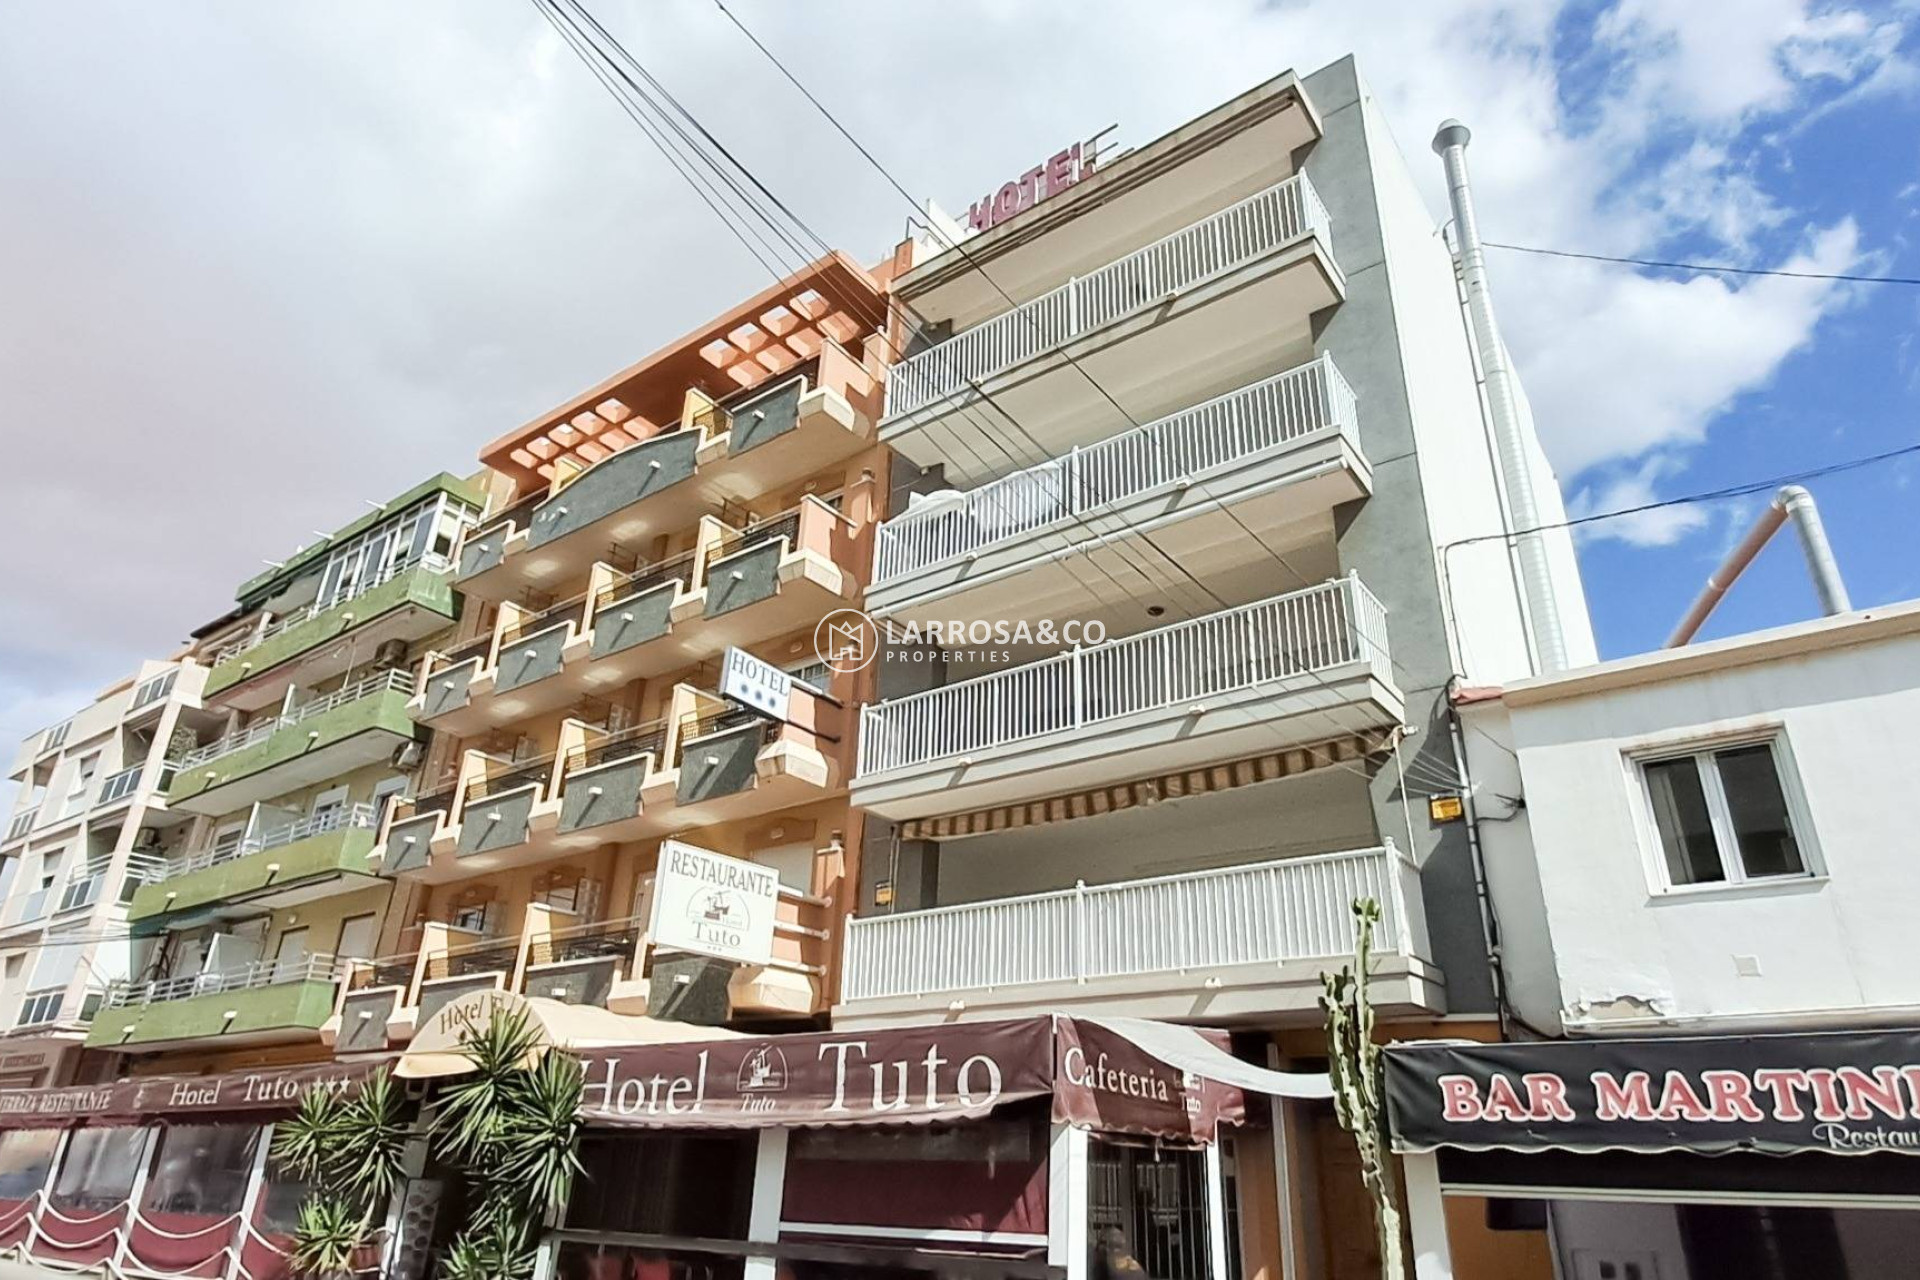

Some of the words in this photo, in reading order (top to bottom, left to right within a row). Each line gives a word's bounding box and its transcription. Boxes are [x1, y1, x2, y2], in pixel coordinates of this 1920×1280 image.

[968, 141, 1097, 232] HOTEL
[731, 652, 788, 697] HOTEL
[670, 850, 774, 898] RESTAURANTE
[692, 920, 741, 947] Tuto
[440, 995, 485, 1035] Hotel
[168, 1080, 222, 1106] Hotel
[243, 1075, 299, 1102] Tuto
[572, 1050, 709, 1115] Hotel
[818, 1041, 1002, 1113] Tuto
[1065, 1047, 1169, 1102] Cafeteria
[1437, 1073, 1576, 1122] BAR
[739, 1093, 776, 1113] Tuto
